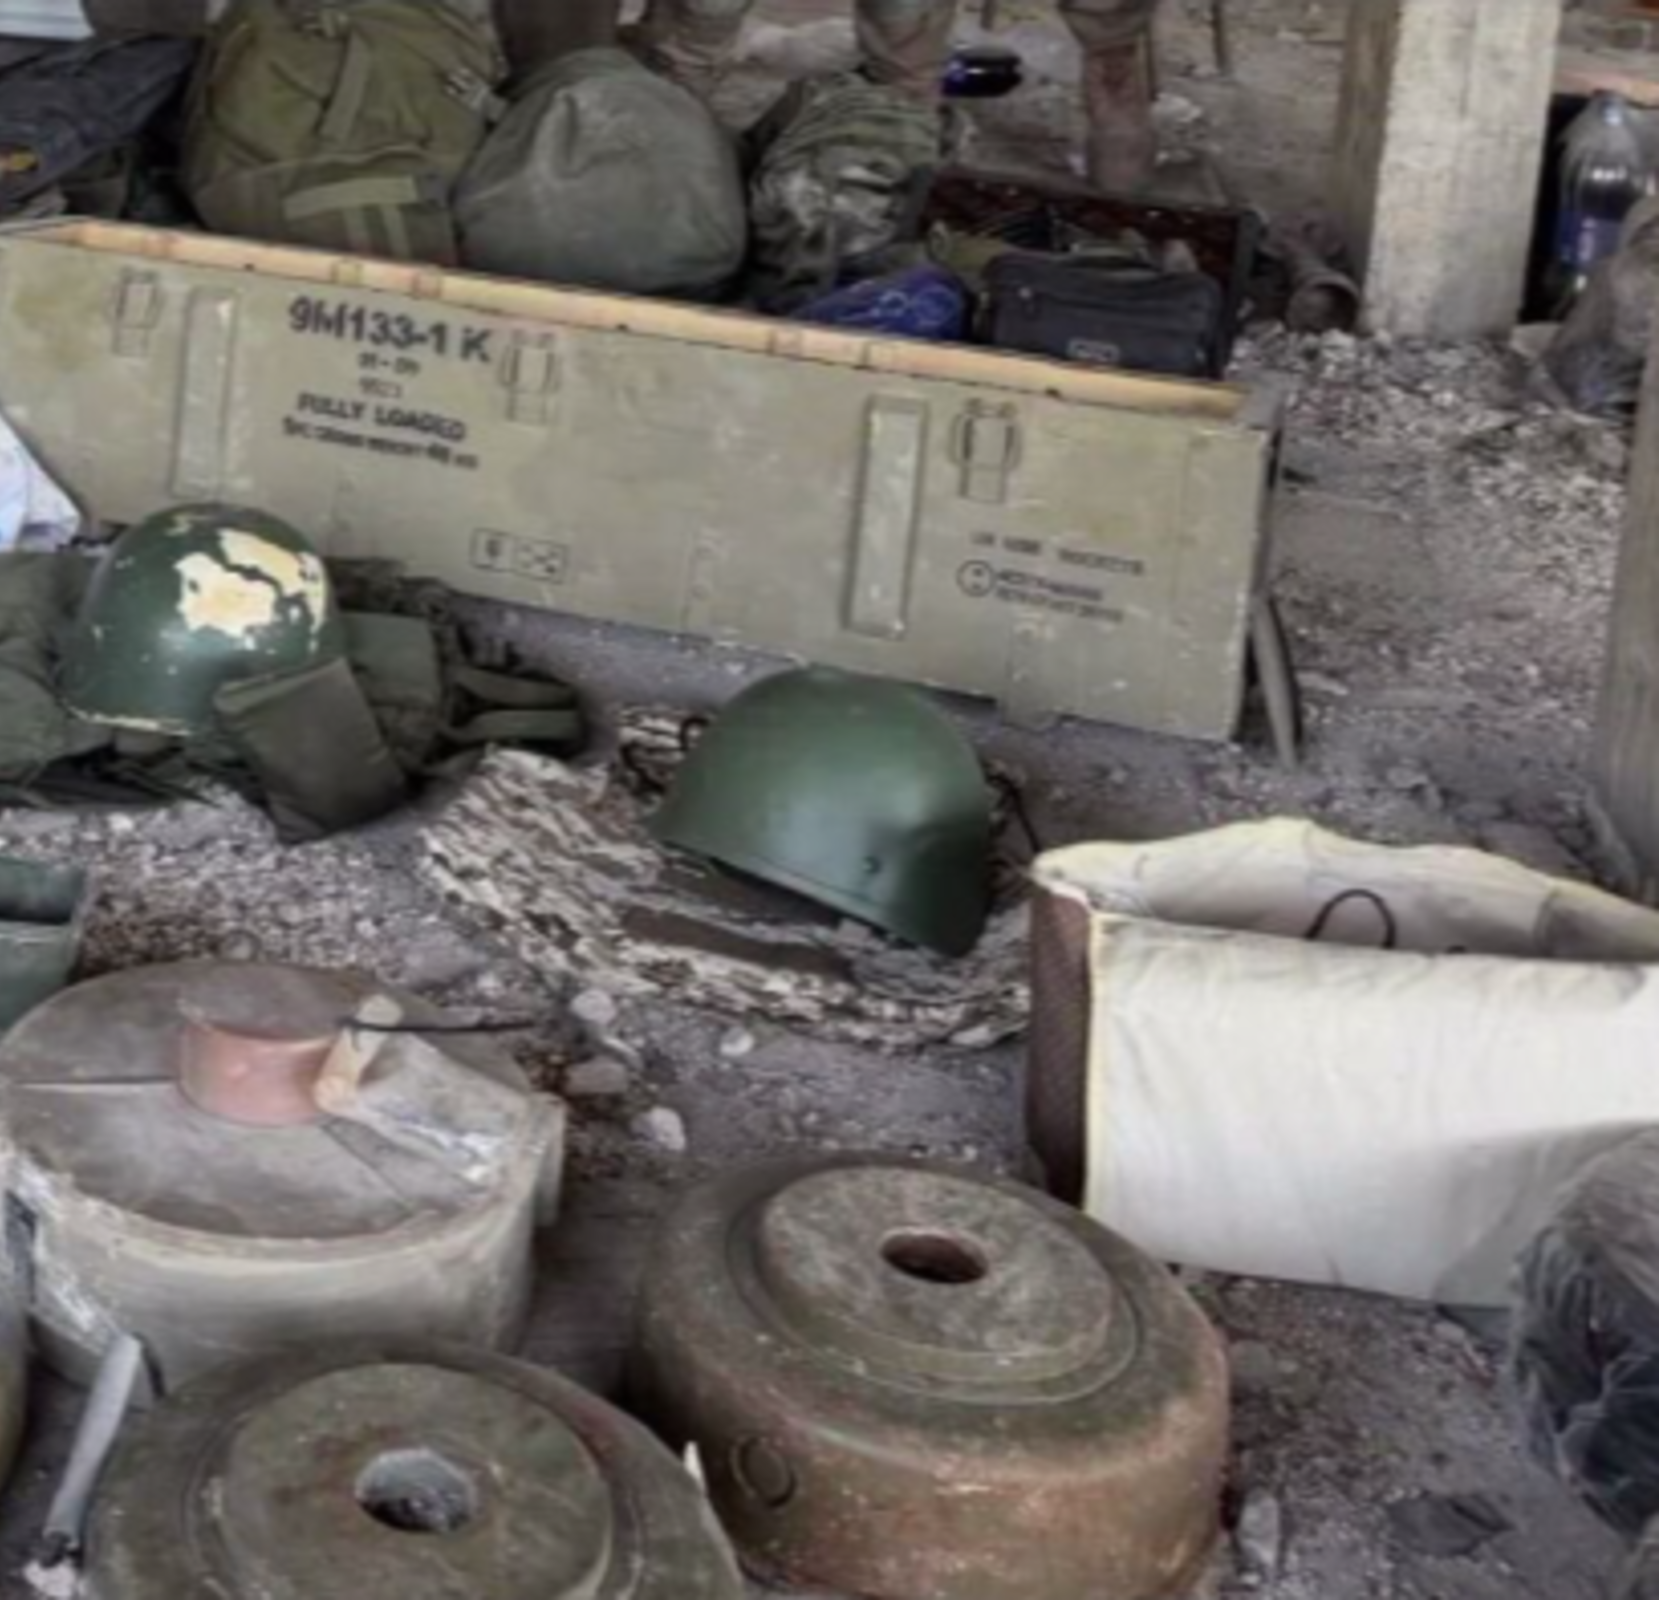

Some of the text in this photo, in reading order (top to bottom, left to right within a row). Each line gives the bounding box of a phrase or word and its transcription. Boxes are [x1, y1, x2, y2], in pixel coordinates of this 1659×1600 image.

[288, 296, 449, 356] 9M133-1
[297, 392, 467, 442] FULLY LOADED
